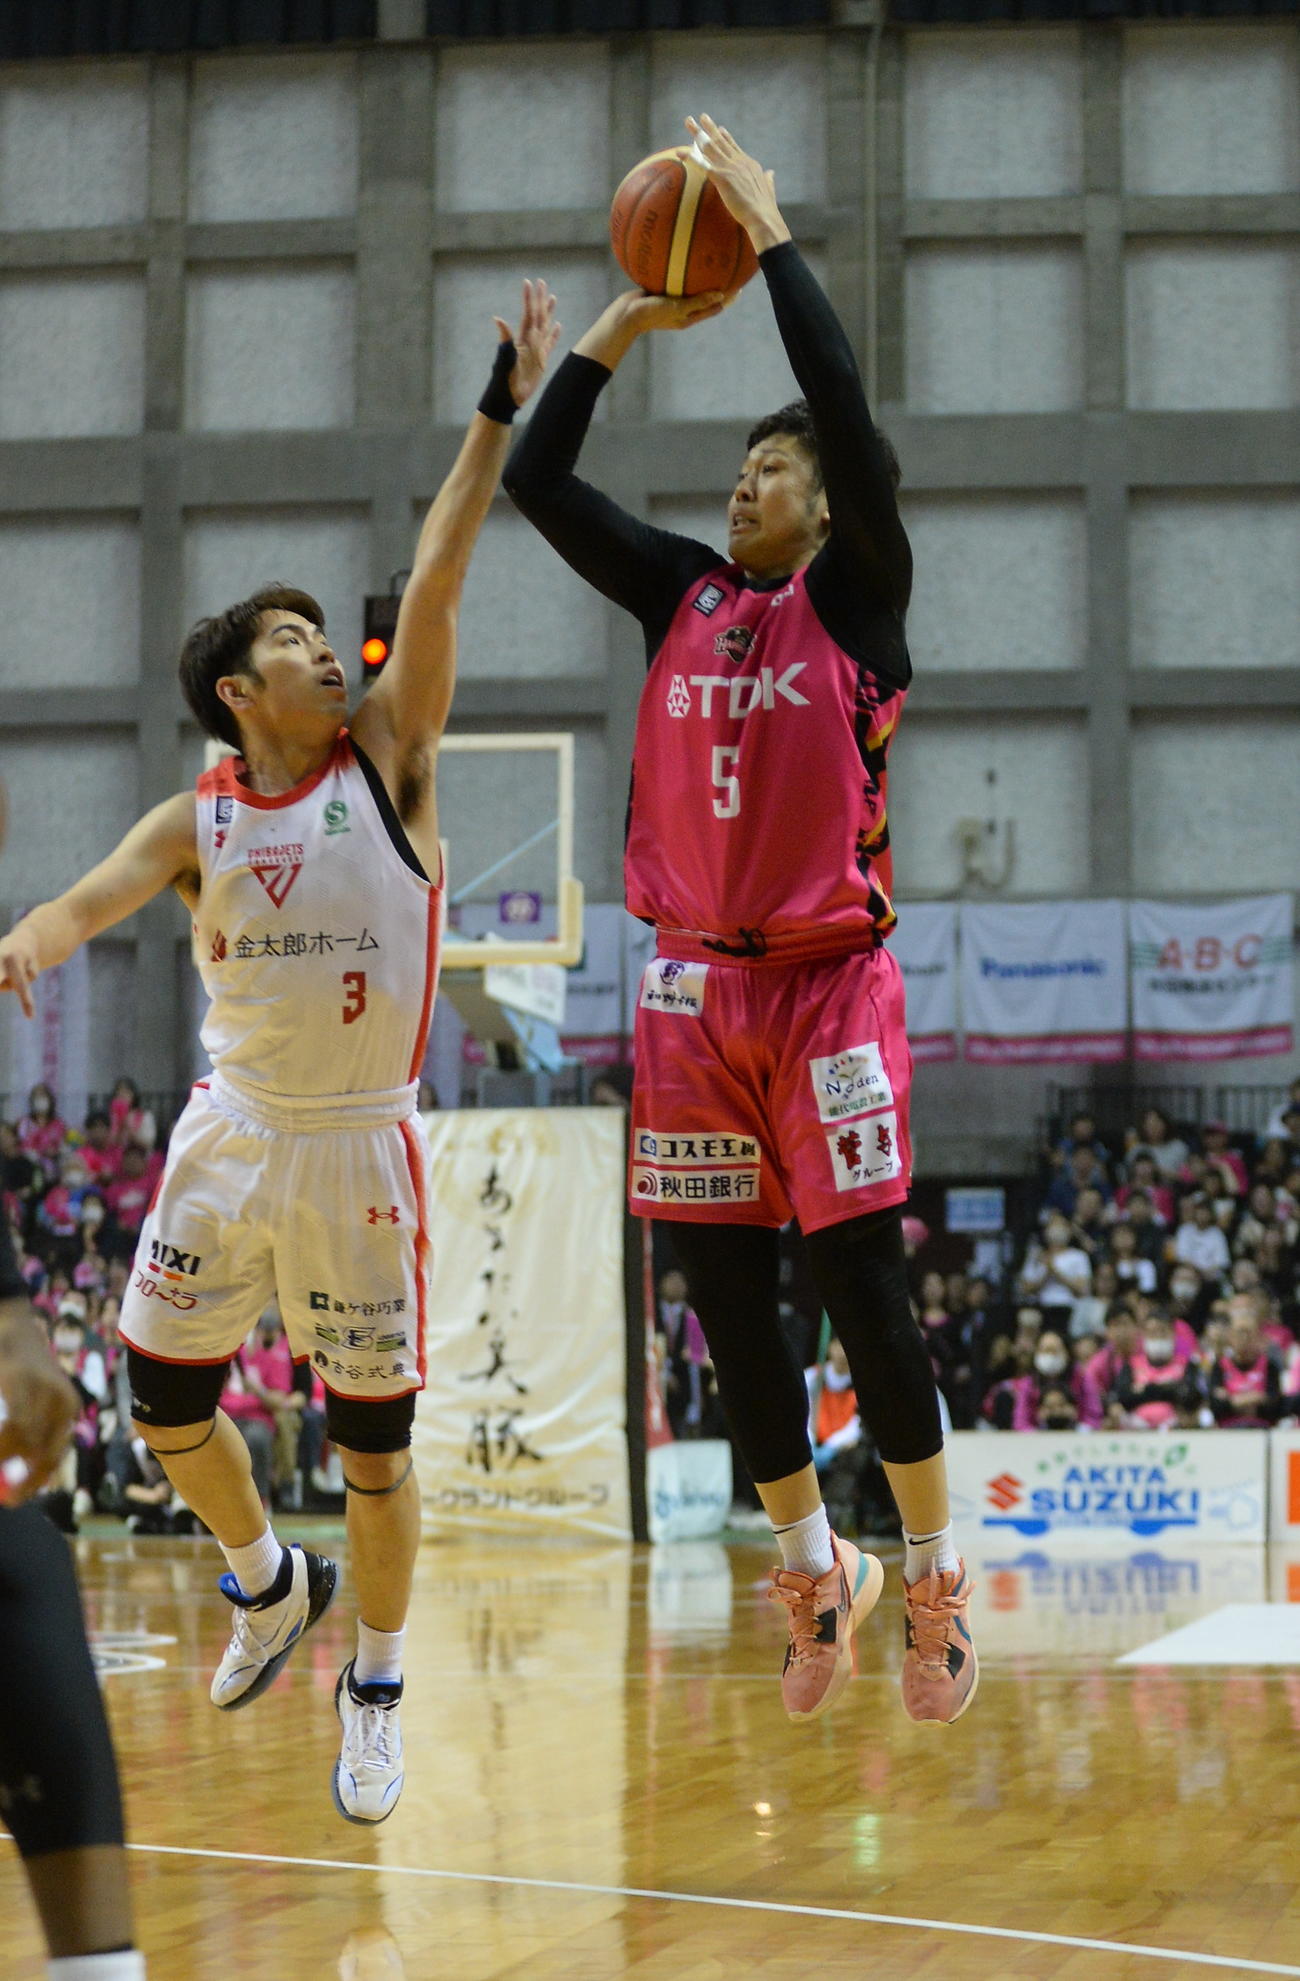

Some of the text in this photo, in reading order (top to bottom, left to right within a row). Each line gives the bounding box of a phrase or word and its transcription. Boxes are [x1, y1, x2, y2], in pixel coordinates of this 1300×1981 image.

[689, 662, 811, 718] TDK
[712, 745, 740, 818] 5
[234, 928, 380, 958] 金太郎ホーム
[342, 971, 366, 1024] 3
[659, 1174, 755, 1198] 秋田銀行
[1065, 1466, 1166, 1484] AKITA
[1030, 1488, 1199, 1513] SUZUKI
